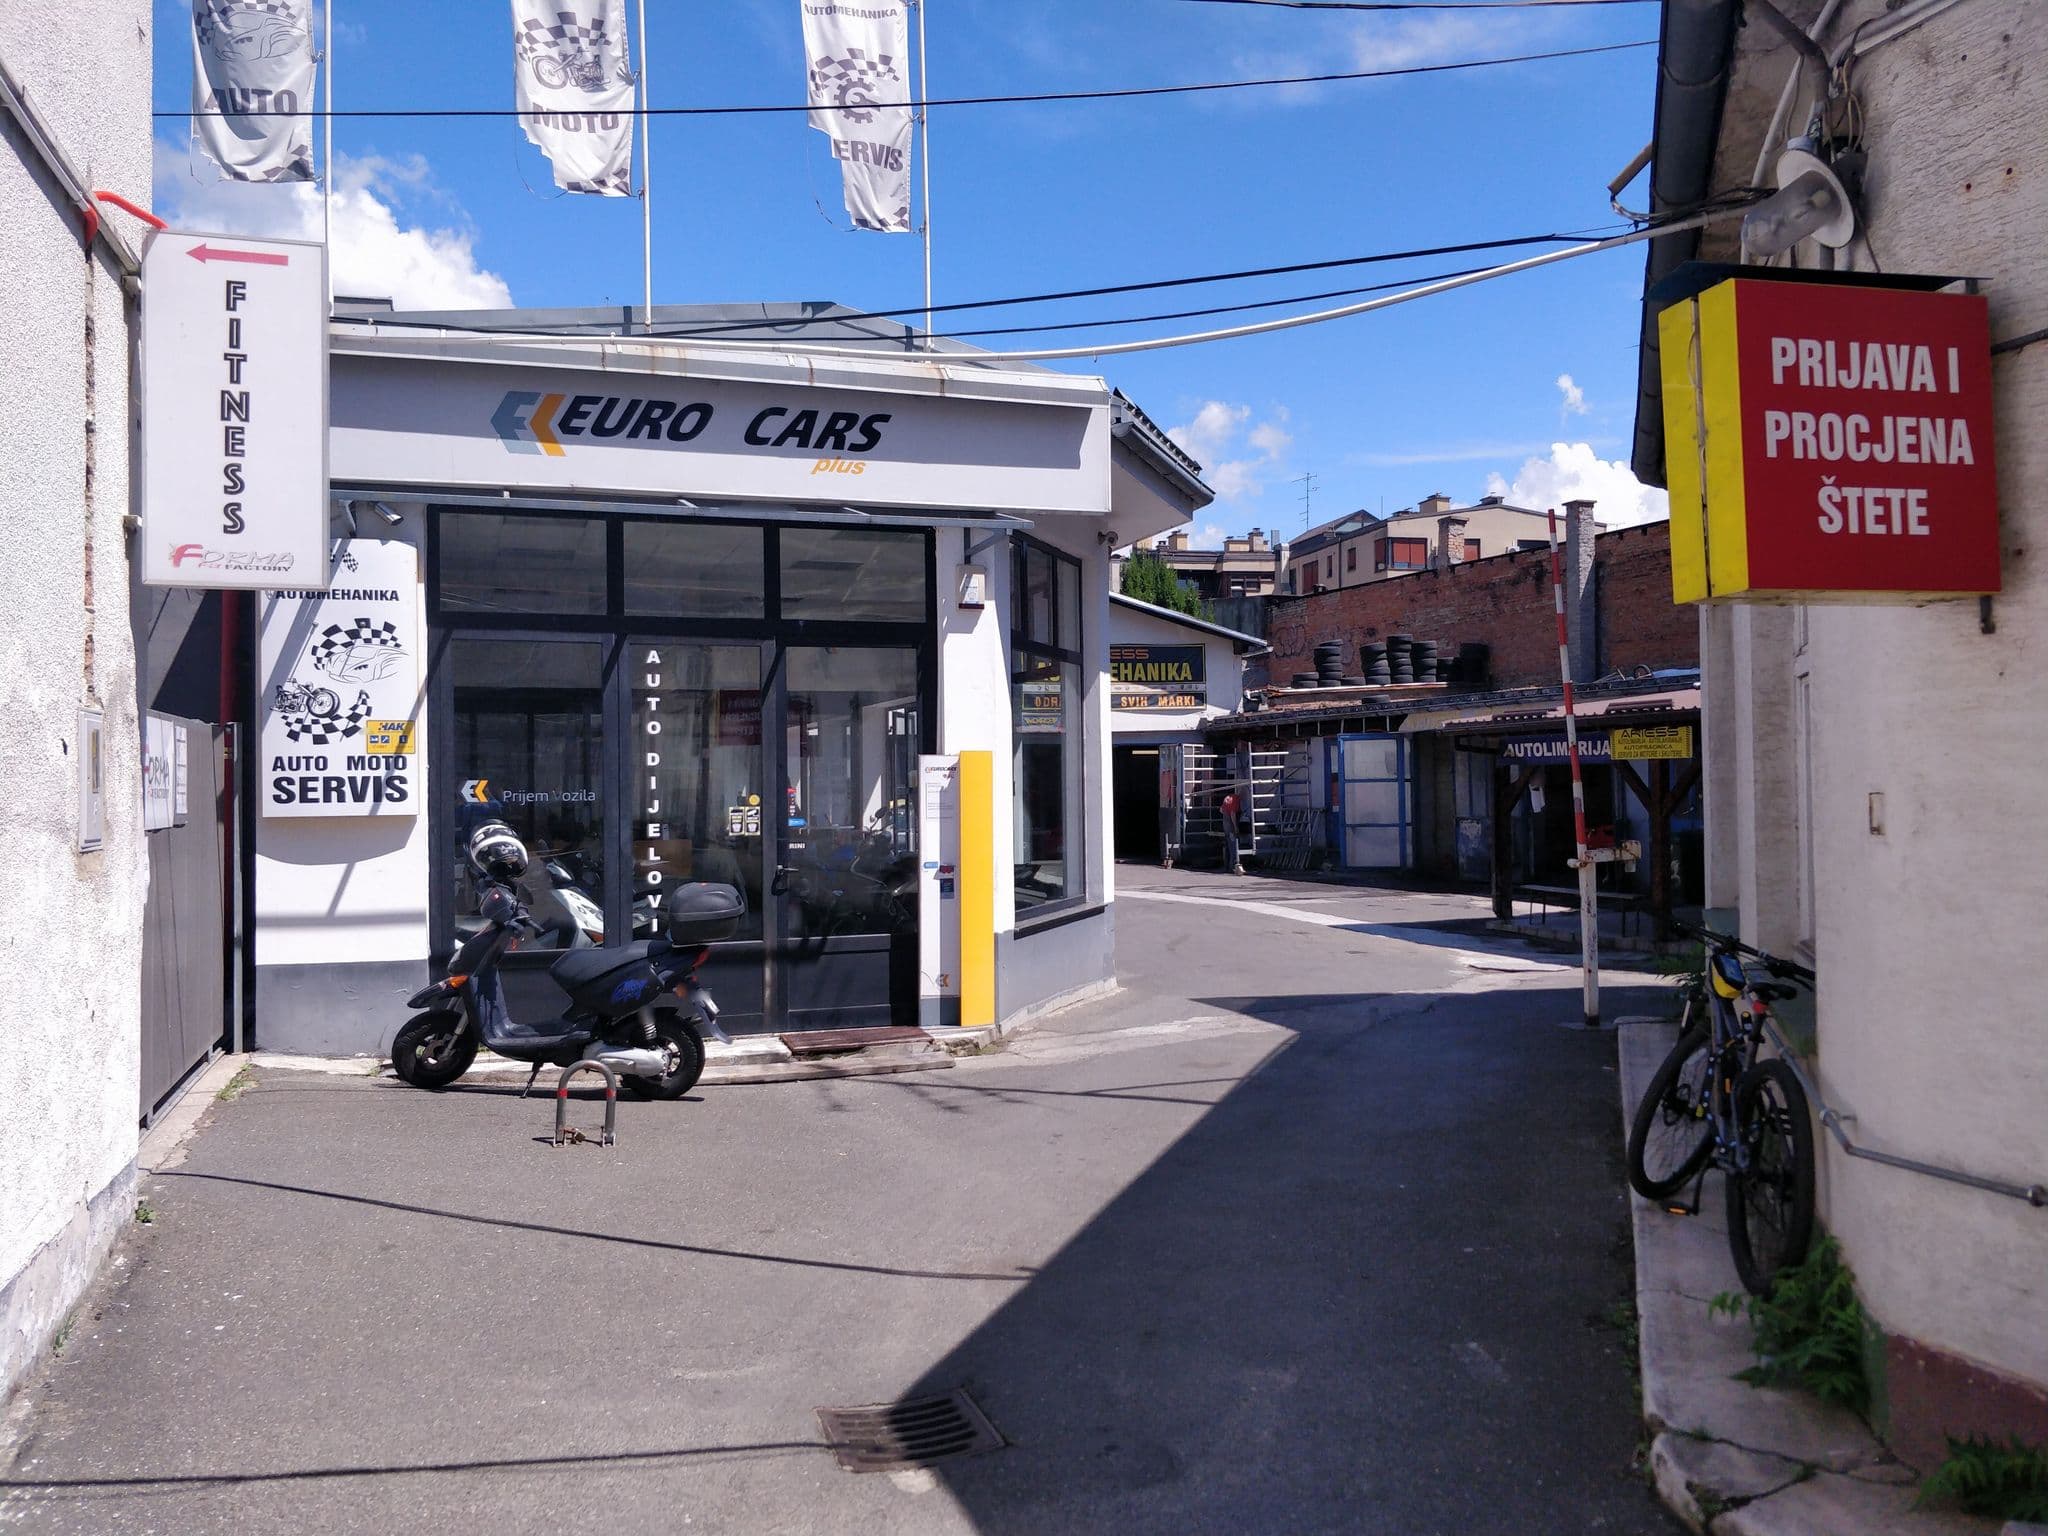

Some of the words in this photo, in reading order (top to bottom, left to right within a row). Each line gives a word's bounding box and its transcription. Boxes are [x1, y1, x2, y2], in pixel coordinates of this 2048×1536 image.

[204, 87, 298, 117] AUTO
[532, 102, 619, 133] MOTO
[1770, 337, 1937, 393] PRIJAVA
[1947, 346, 1960, 393] I
[220, 279, 251, 534] FITNESS
[557, 396, 714, 442] EURO
[743, 406, 892, 452] CARS
[1764, 410, 1975, 466] PROCJENA
[811, 456, 867, 475] plus
[1817, 475, 1930, 536] ŠTETE
[1120, 696, 1148, 708] SVIH
[1158, 695, 1196, 708] MARKI
[272, 756, 329, 772] AUTO
[346, 755, 408, 772] MOTO
[272, 776, 409, 804] SERVIS
[503, 790, 549, 806] Prijem
